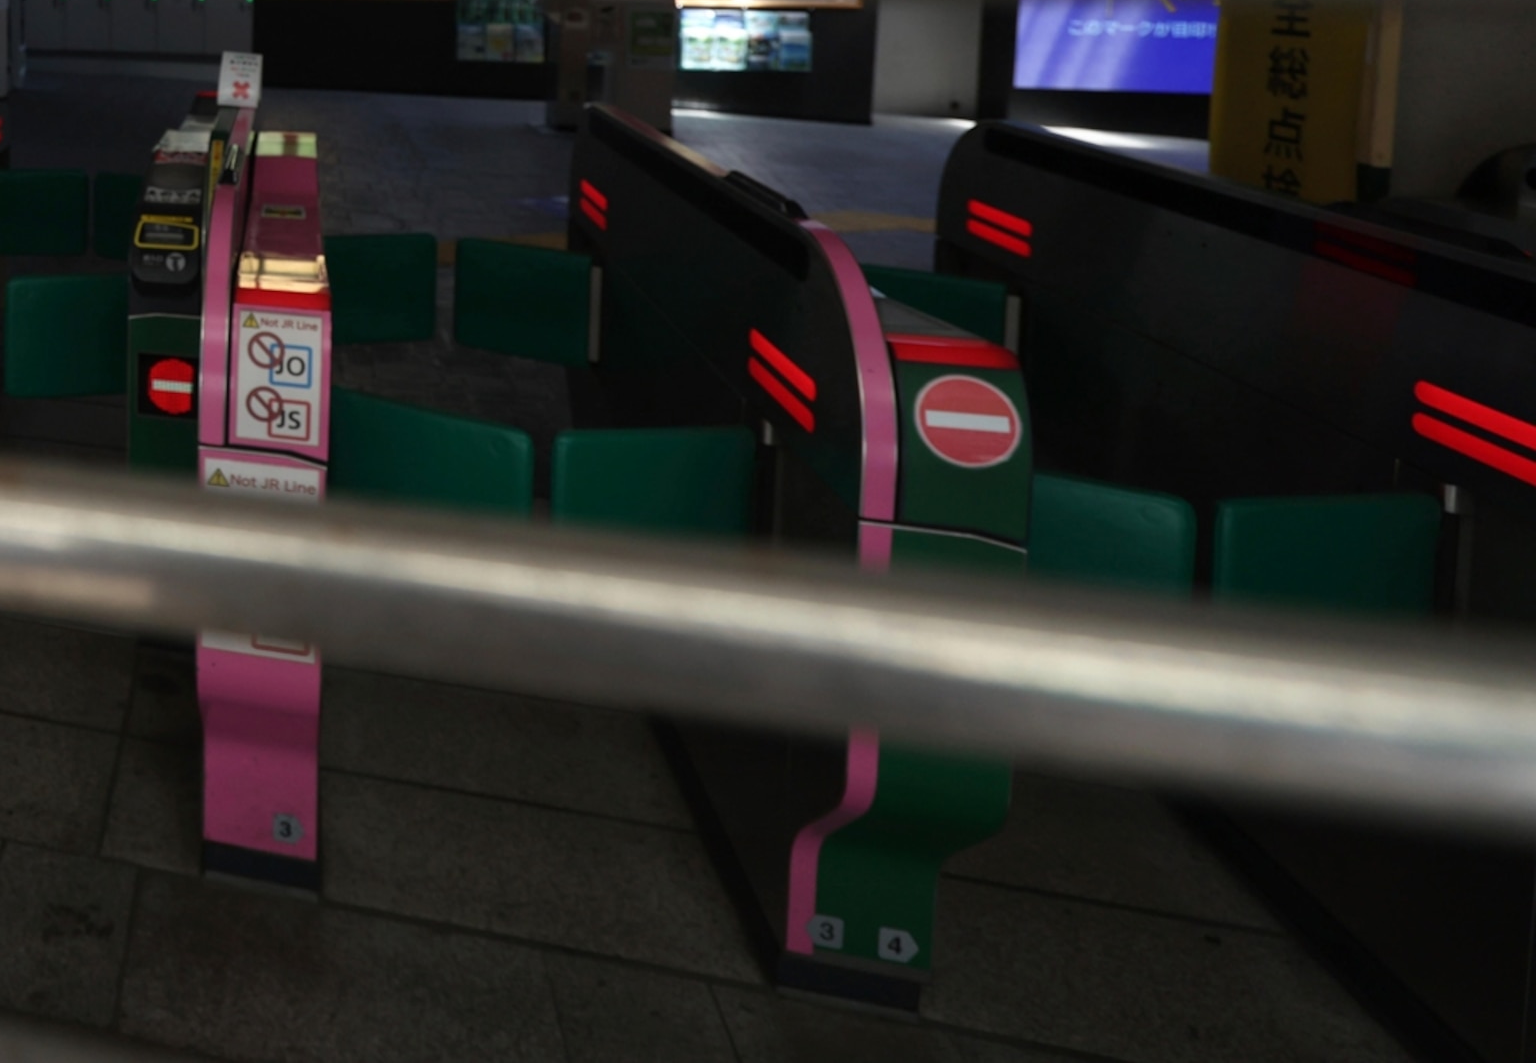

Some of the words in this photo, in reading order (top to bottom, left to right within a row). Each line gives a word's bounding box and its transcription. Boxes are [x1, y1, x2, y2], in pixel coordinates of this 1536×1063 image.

[260, 318, 278, 328] Not
[280, 319, 295, 330] JR
[297, 319, 318, 332] Line
[275, 356, 305, 377] JO
[276, 409, 302, 430] JS
[229, 474, 257, 488] Not
[261, 476, 280, 491] JR
[283, 477, 317, 496] Line
[279, 821, 292, 838] 3
[819, 922, 834, 941] 3
[887, 937, 902, 954] 4
